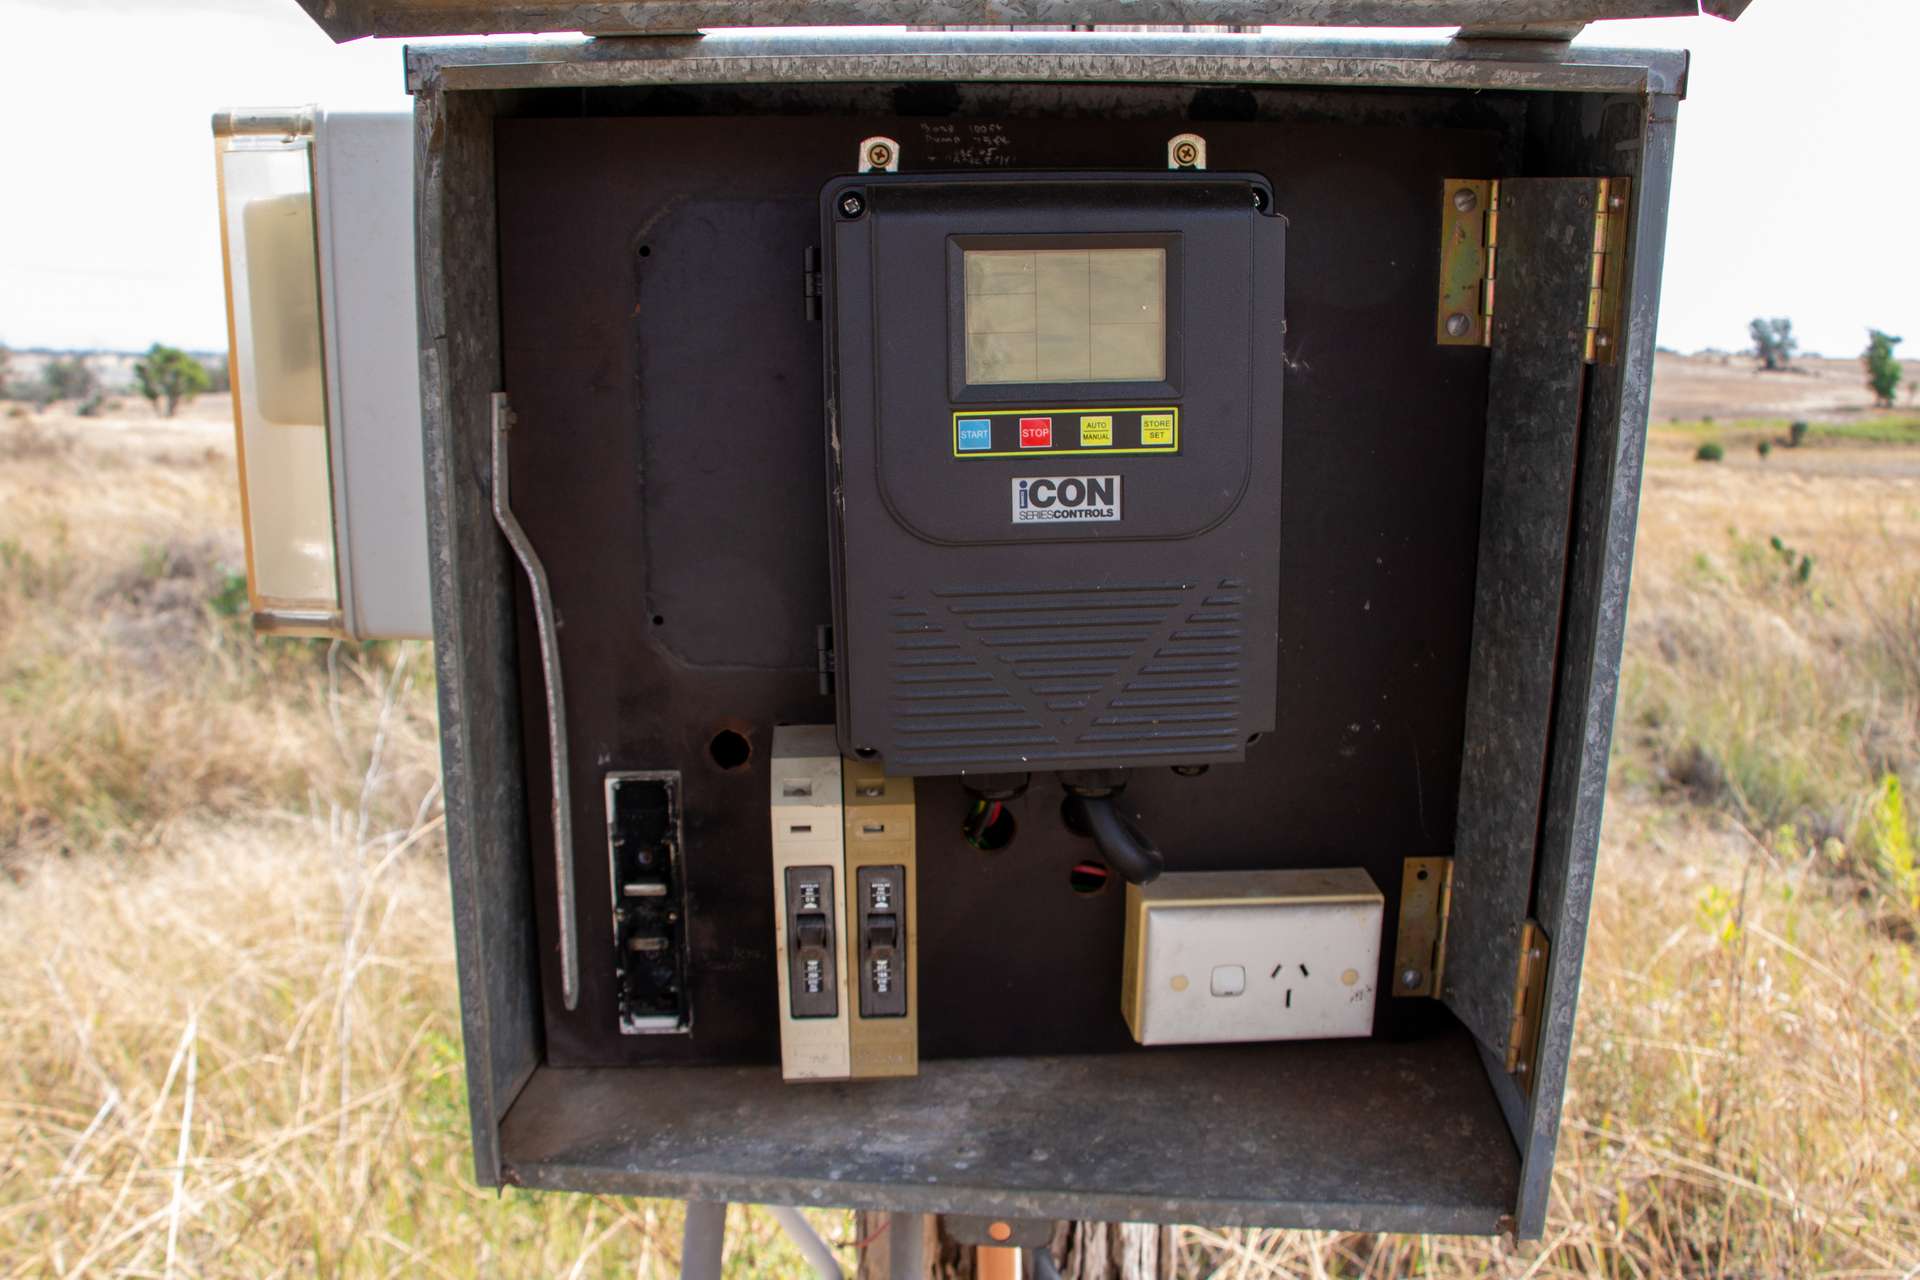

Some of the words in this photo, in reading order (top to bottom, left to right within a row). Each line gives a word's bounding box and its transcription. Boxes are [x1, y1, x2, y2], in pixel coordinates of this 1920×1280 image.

[1086, 421, 1107, 430] AUTO
[1143, 419, 1170, 428] STORE
[960, 429, 988, 440] START
[1022, 428, 1049, 439] STOP
[1083, 432, 1110, 441] MANUAL
[1150, 431, 1164, 439] SET
[1019, 478, 1114, 509] iCON
